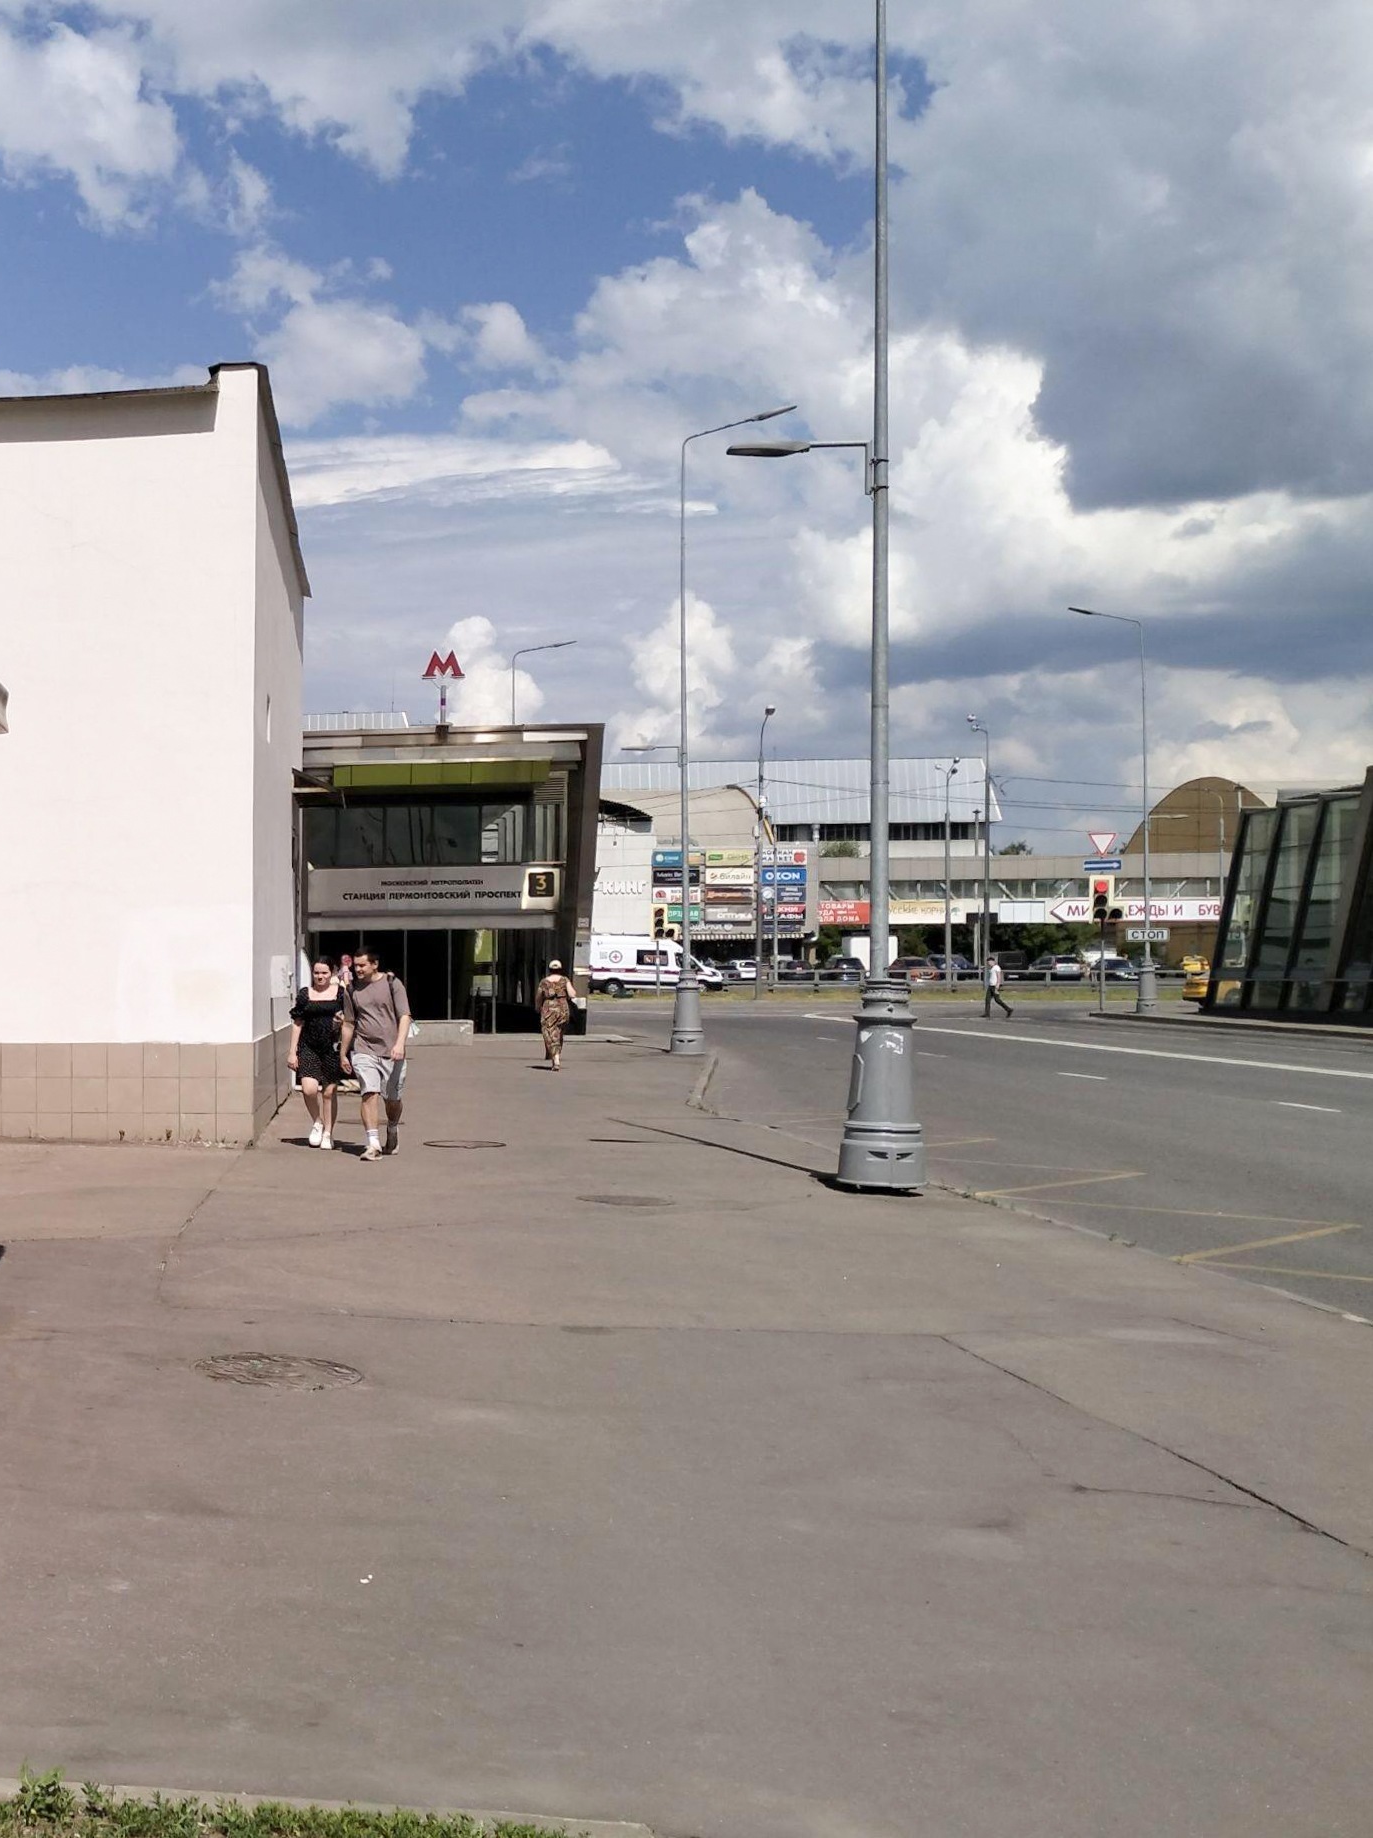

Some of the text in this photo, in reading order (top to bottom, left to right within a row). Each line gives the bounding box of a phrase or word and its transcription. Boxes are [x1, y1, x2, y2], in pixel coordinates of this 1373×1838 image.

[719, 872, 751, 880] билайн
[535, 875, 547, 891] 3
[342, 889, 522, 902] СТАНЦИЯ ЛЕРМОНТОВСКИЙ ПРОСПЕКТ
[1131, 930, 1165, 940] СТОП
